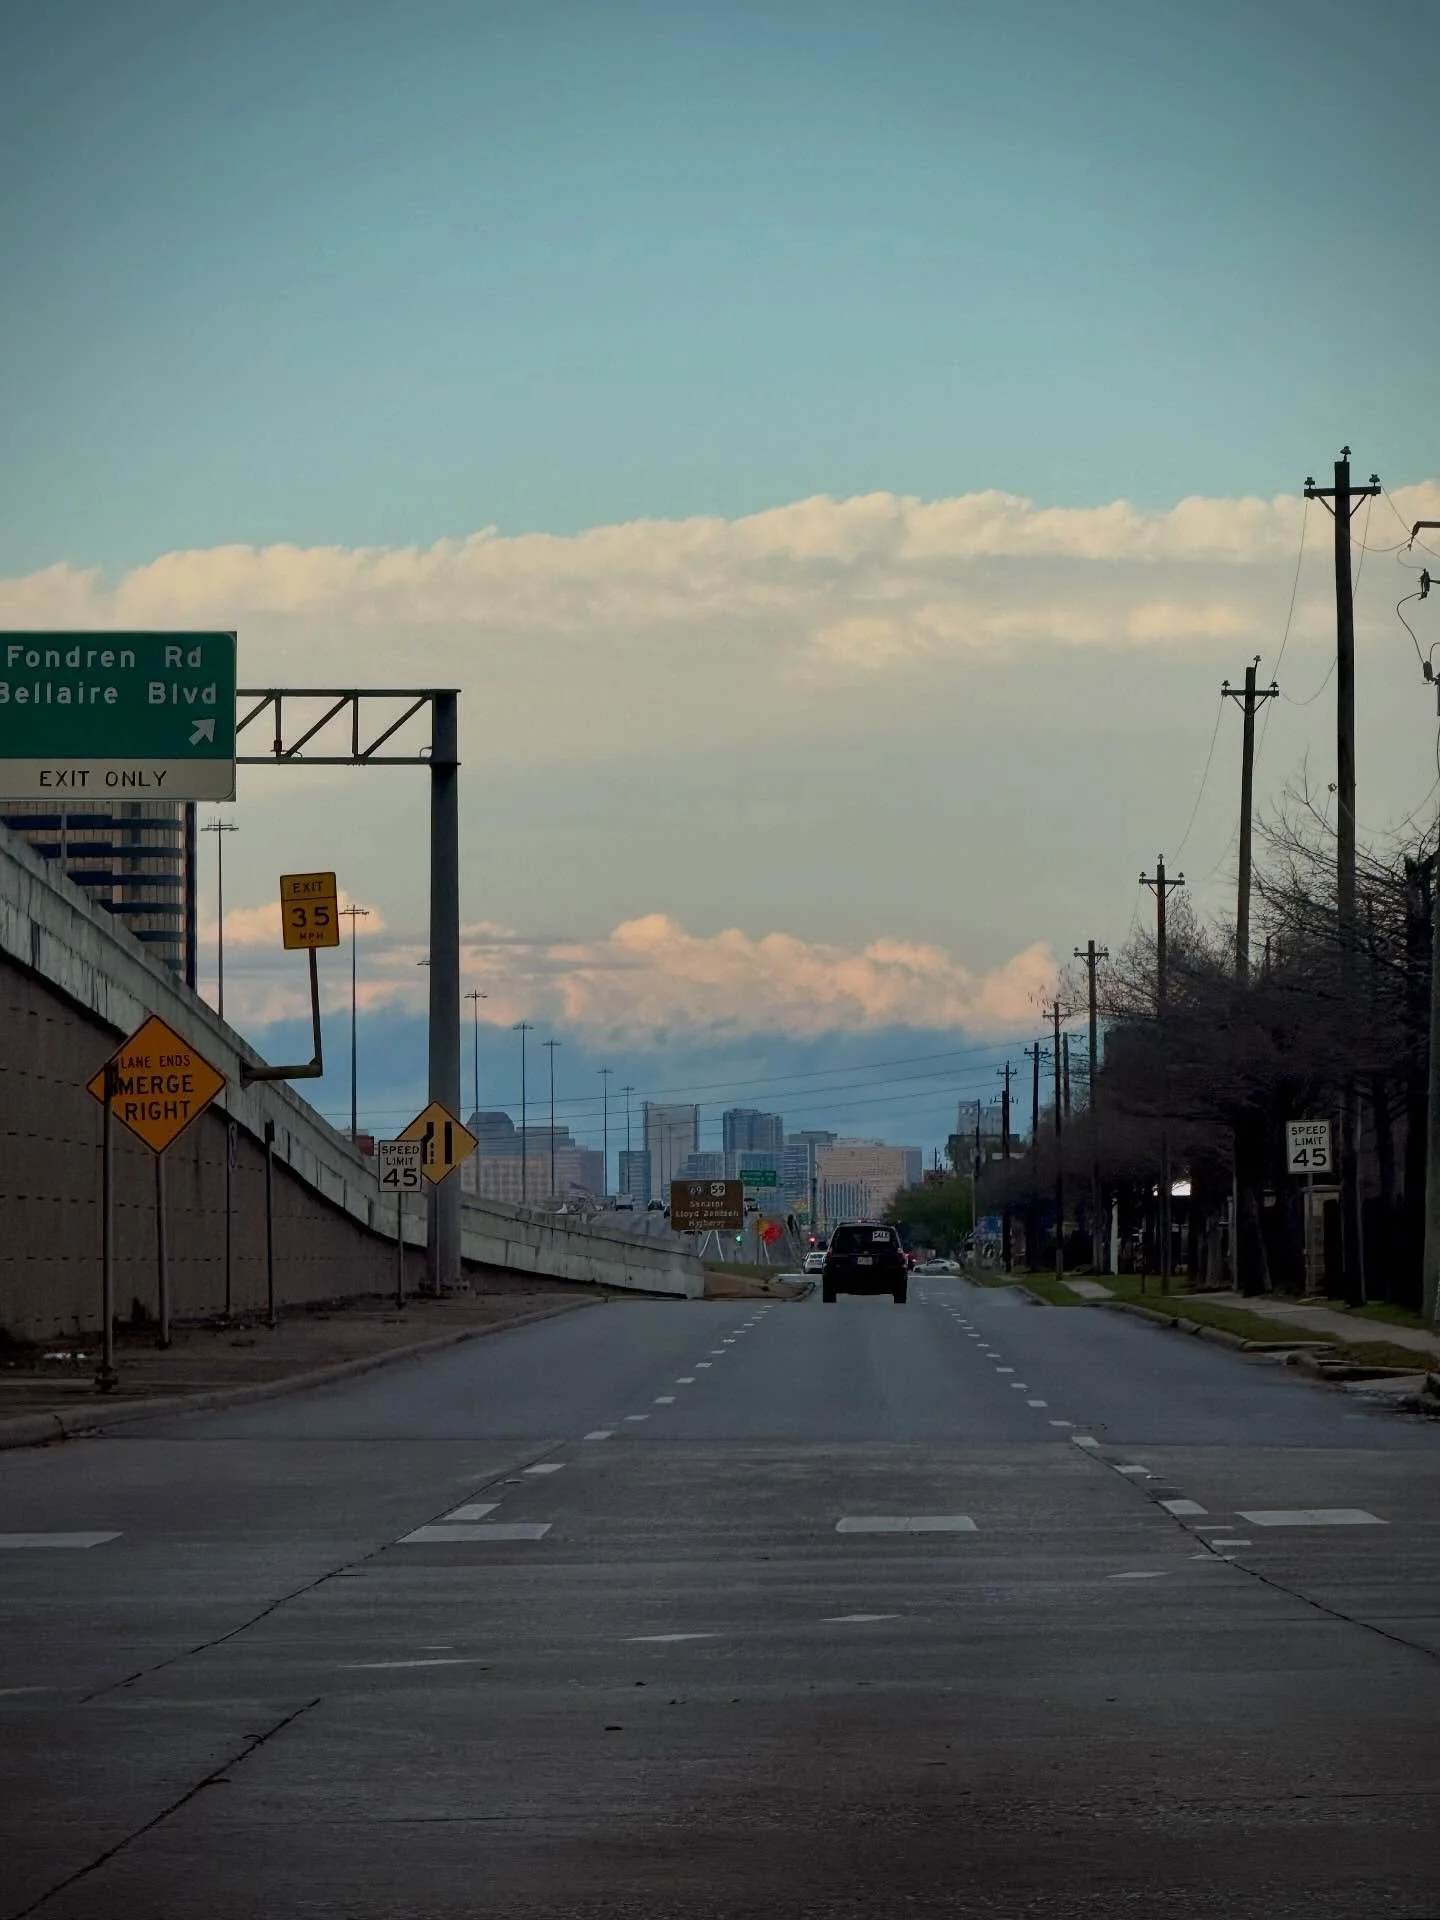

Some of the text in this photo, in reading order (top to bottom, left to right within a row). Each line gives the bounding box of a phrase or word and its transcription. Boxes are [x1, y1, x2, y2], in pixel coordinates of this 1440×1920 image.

[7, 645, 203, 668] Fondren Rd
[0, 681, 217, 705] Bellaire Blvd
[39, 769, 168, 788] EXIT ONLY
[292, 880, 325, 895] EXIT
[290, 905, 331, 928] 35
[298, 930, 325, 942] MPH
[120, 1054, 191, 1069] LANE ENDS
[118, 1074, 194, 1096] MERGE
[125, 1100, 192, 1122] RIGHT
[1291, 1126, 1327, 1135] SPEED
[1295, 1137, 1323, 1146] LIMIT
[382, 1145, 419, 1155] SPEED
[1293, 1148, 1327, 1167] 45
[386, 1157, 413, 1166] LIMIT
[383, 1168, 418, 1187] 45
[712, 1185, 725, 1194] 59
[675, 1210, 700, 1219] Lloyd
